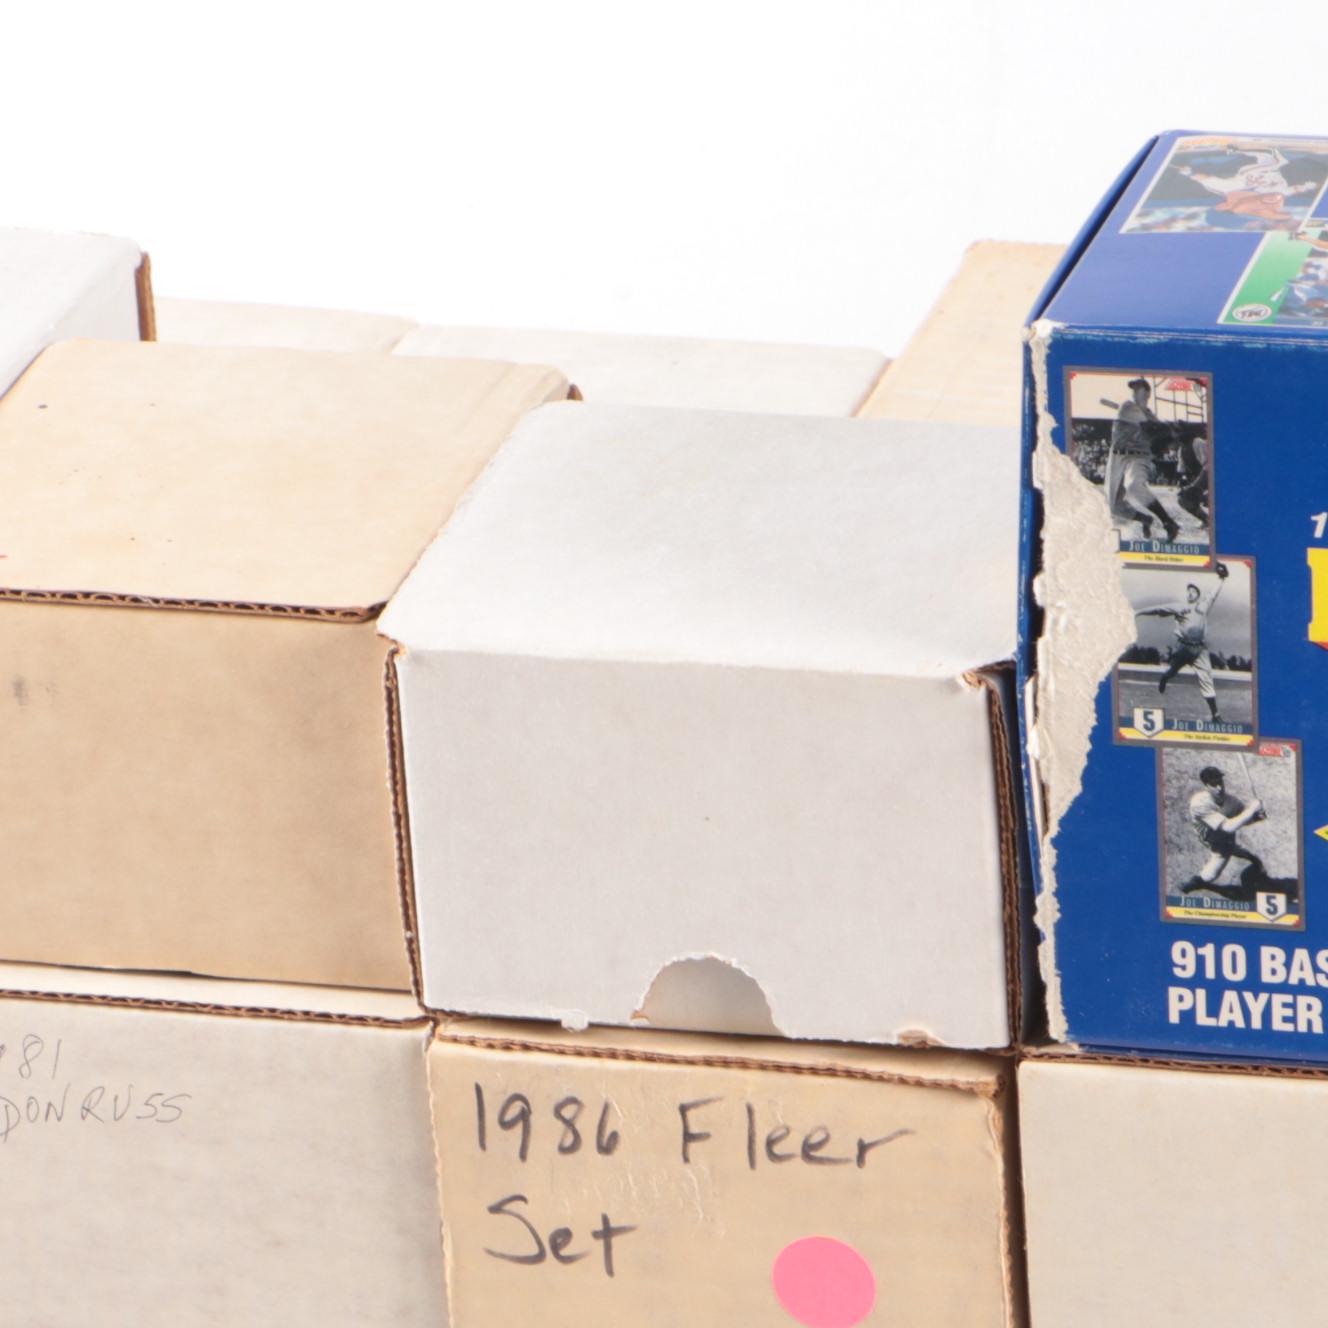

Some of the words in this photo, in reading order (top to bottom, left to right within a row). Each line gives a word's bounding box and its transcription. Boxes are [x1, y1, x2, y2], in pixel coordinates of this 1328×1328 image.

[1143, 711, 1156, 731] 5
[1266, 895, 1278, 915] 5
[1171, 940, 1247, 982] 910
[1168, 986, 1324, 1034] PLAYER
[474, 1082, 620, 1162] 1986
[679, 1097, 916, 1170] Fleer
[483, 1194, 638, 1277] Set
